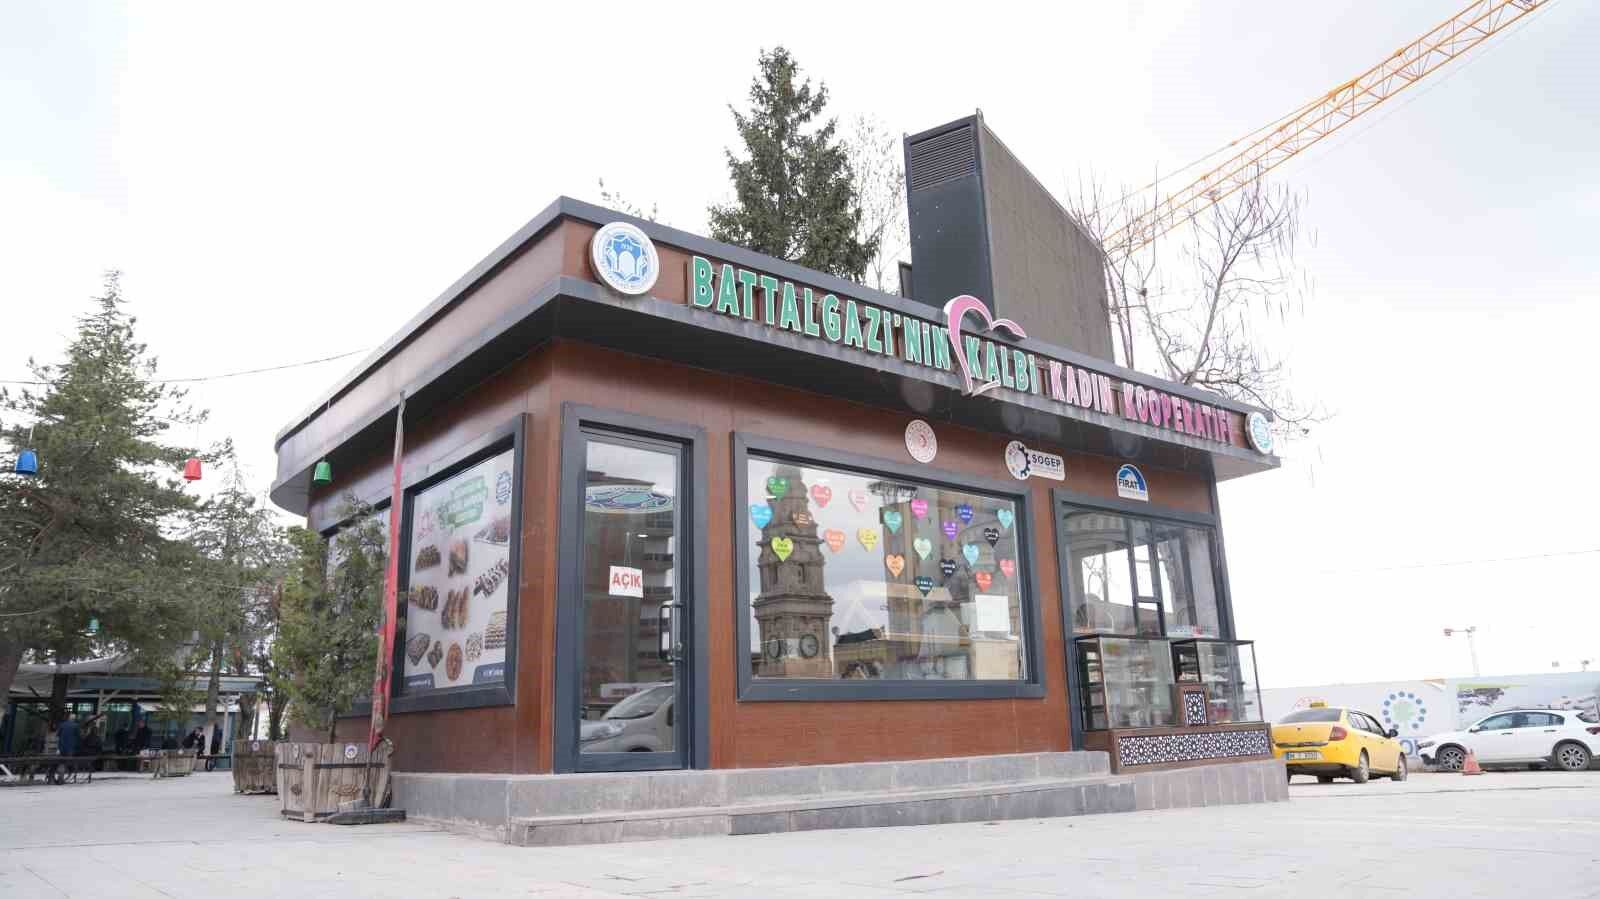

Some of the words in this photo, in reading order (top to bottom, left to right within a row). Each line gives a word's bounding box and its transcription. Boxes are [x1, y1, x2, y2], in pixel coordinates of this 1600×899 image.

[693, 255, 951, 370] BATTALGAZİ'NİN
[965, 335, 1038, 395] KALBİ
[1049, 360, 1114, 415] KADIN
[1031, 453, 1061, 468] SOGEP
[1118, 479, 1138, 490] FIRAT
[612, 572, 641, 589] AÇIK
